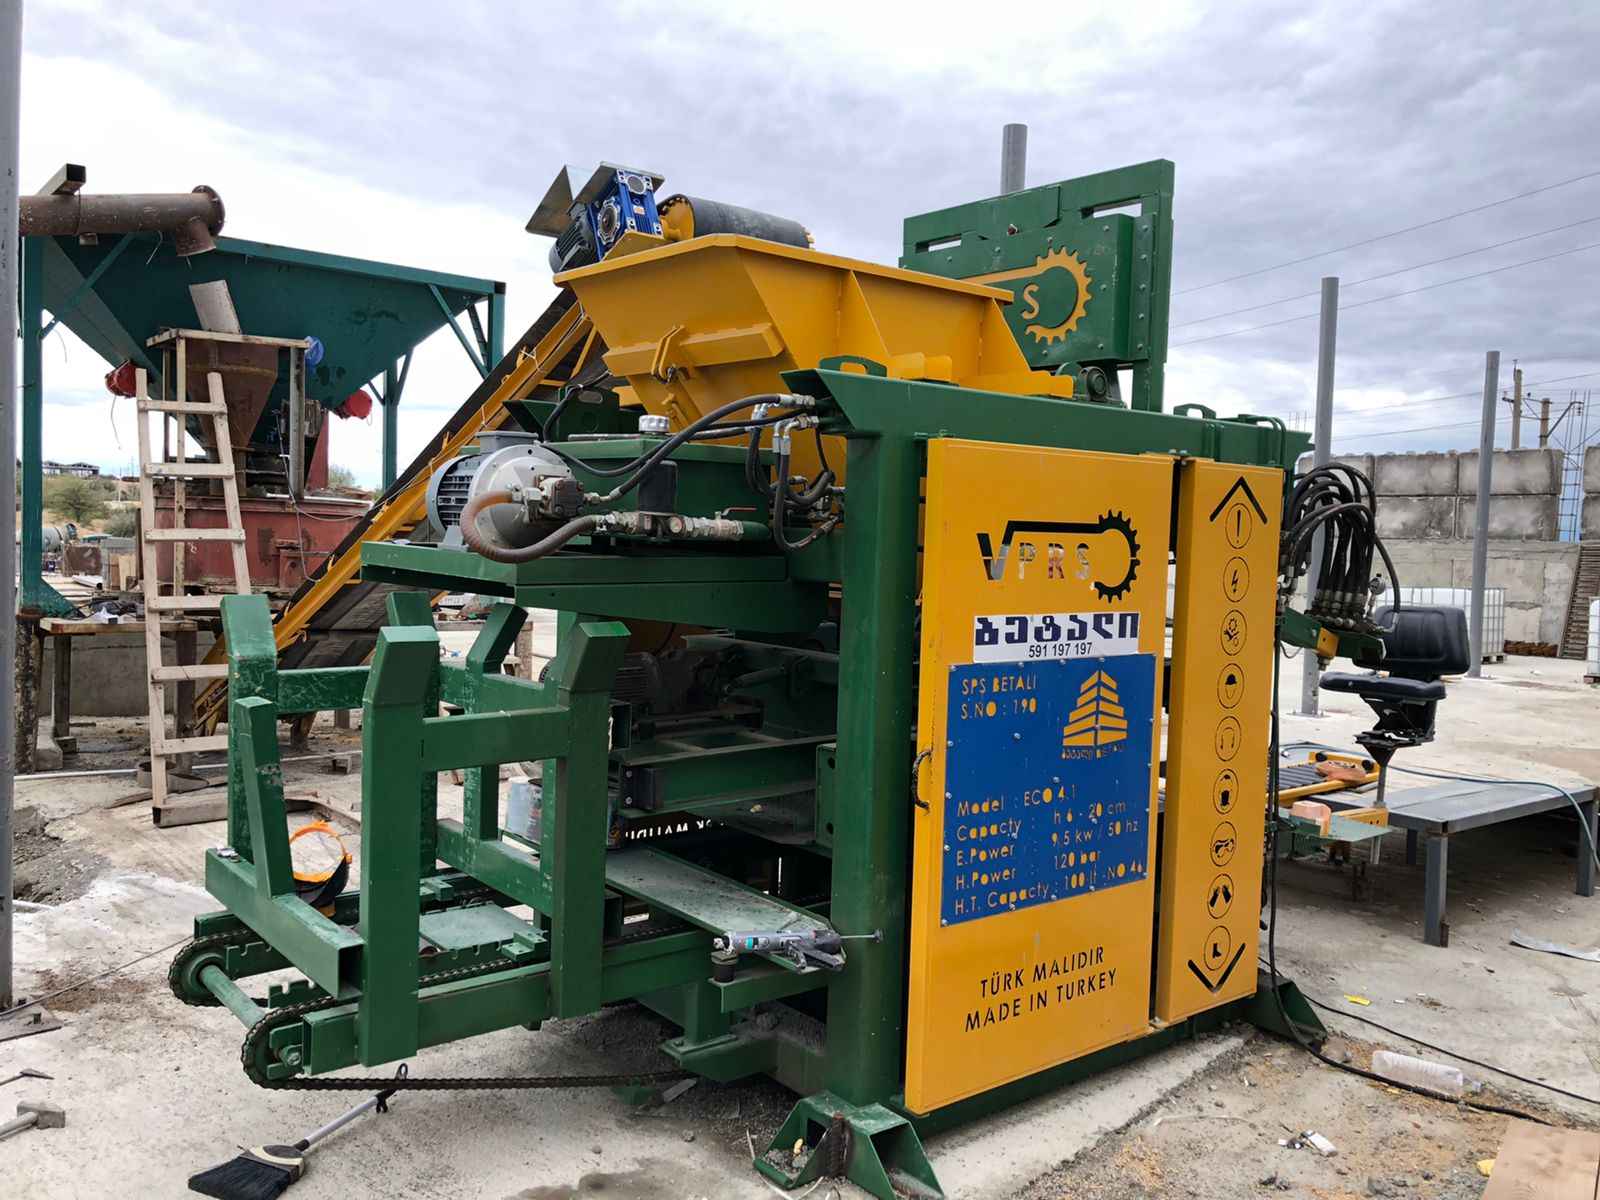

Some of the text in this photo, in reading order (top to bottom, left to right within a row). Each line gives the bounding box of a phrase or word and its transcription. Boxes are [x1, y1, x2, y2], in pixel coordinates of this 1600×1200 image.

[1021, 283, 1040, 320] S
[977, 520, 1090, 580] VPRS
[975, 613, 1140, 646] ბეტალი
[1029, 642, 1093, 658] 591 197 197
[962, 675, 1037, 695] SPS BETALI
[1013, 698, 1037, 715] 190
[957, 795, 1005, 817] Model
[1024, 788, 1053, 807] ECO
[1088, 803, 1103, 819] 20
[1107, 801, 1127, 815] cm
[957, 844, 1015, 866] E.Power
[1075, 828, 1093, 843] kw
[1108, 821, 1121, 837] 50
[1126, 820, 1138, 832] hz
[956, 868, 1016, 890] H.Power
[1054, 852, 1075, 870] 120
[1081, 850, 1101, 864] bar
[1064, 872, 1085, 890] 100
[981, 946, 1104, 998] TÜRK MALIDIR
[965, 968, 1117, 1032] MADE IN TURKEY
